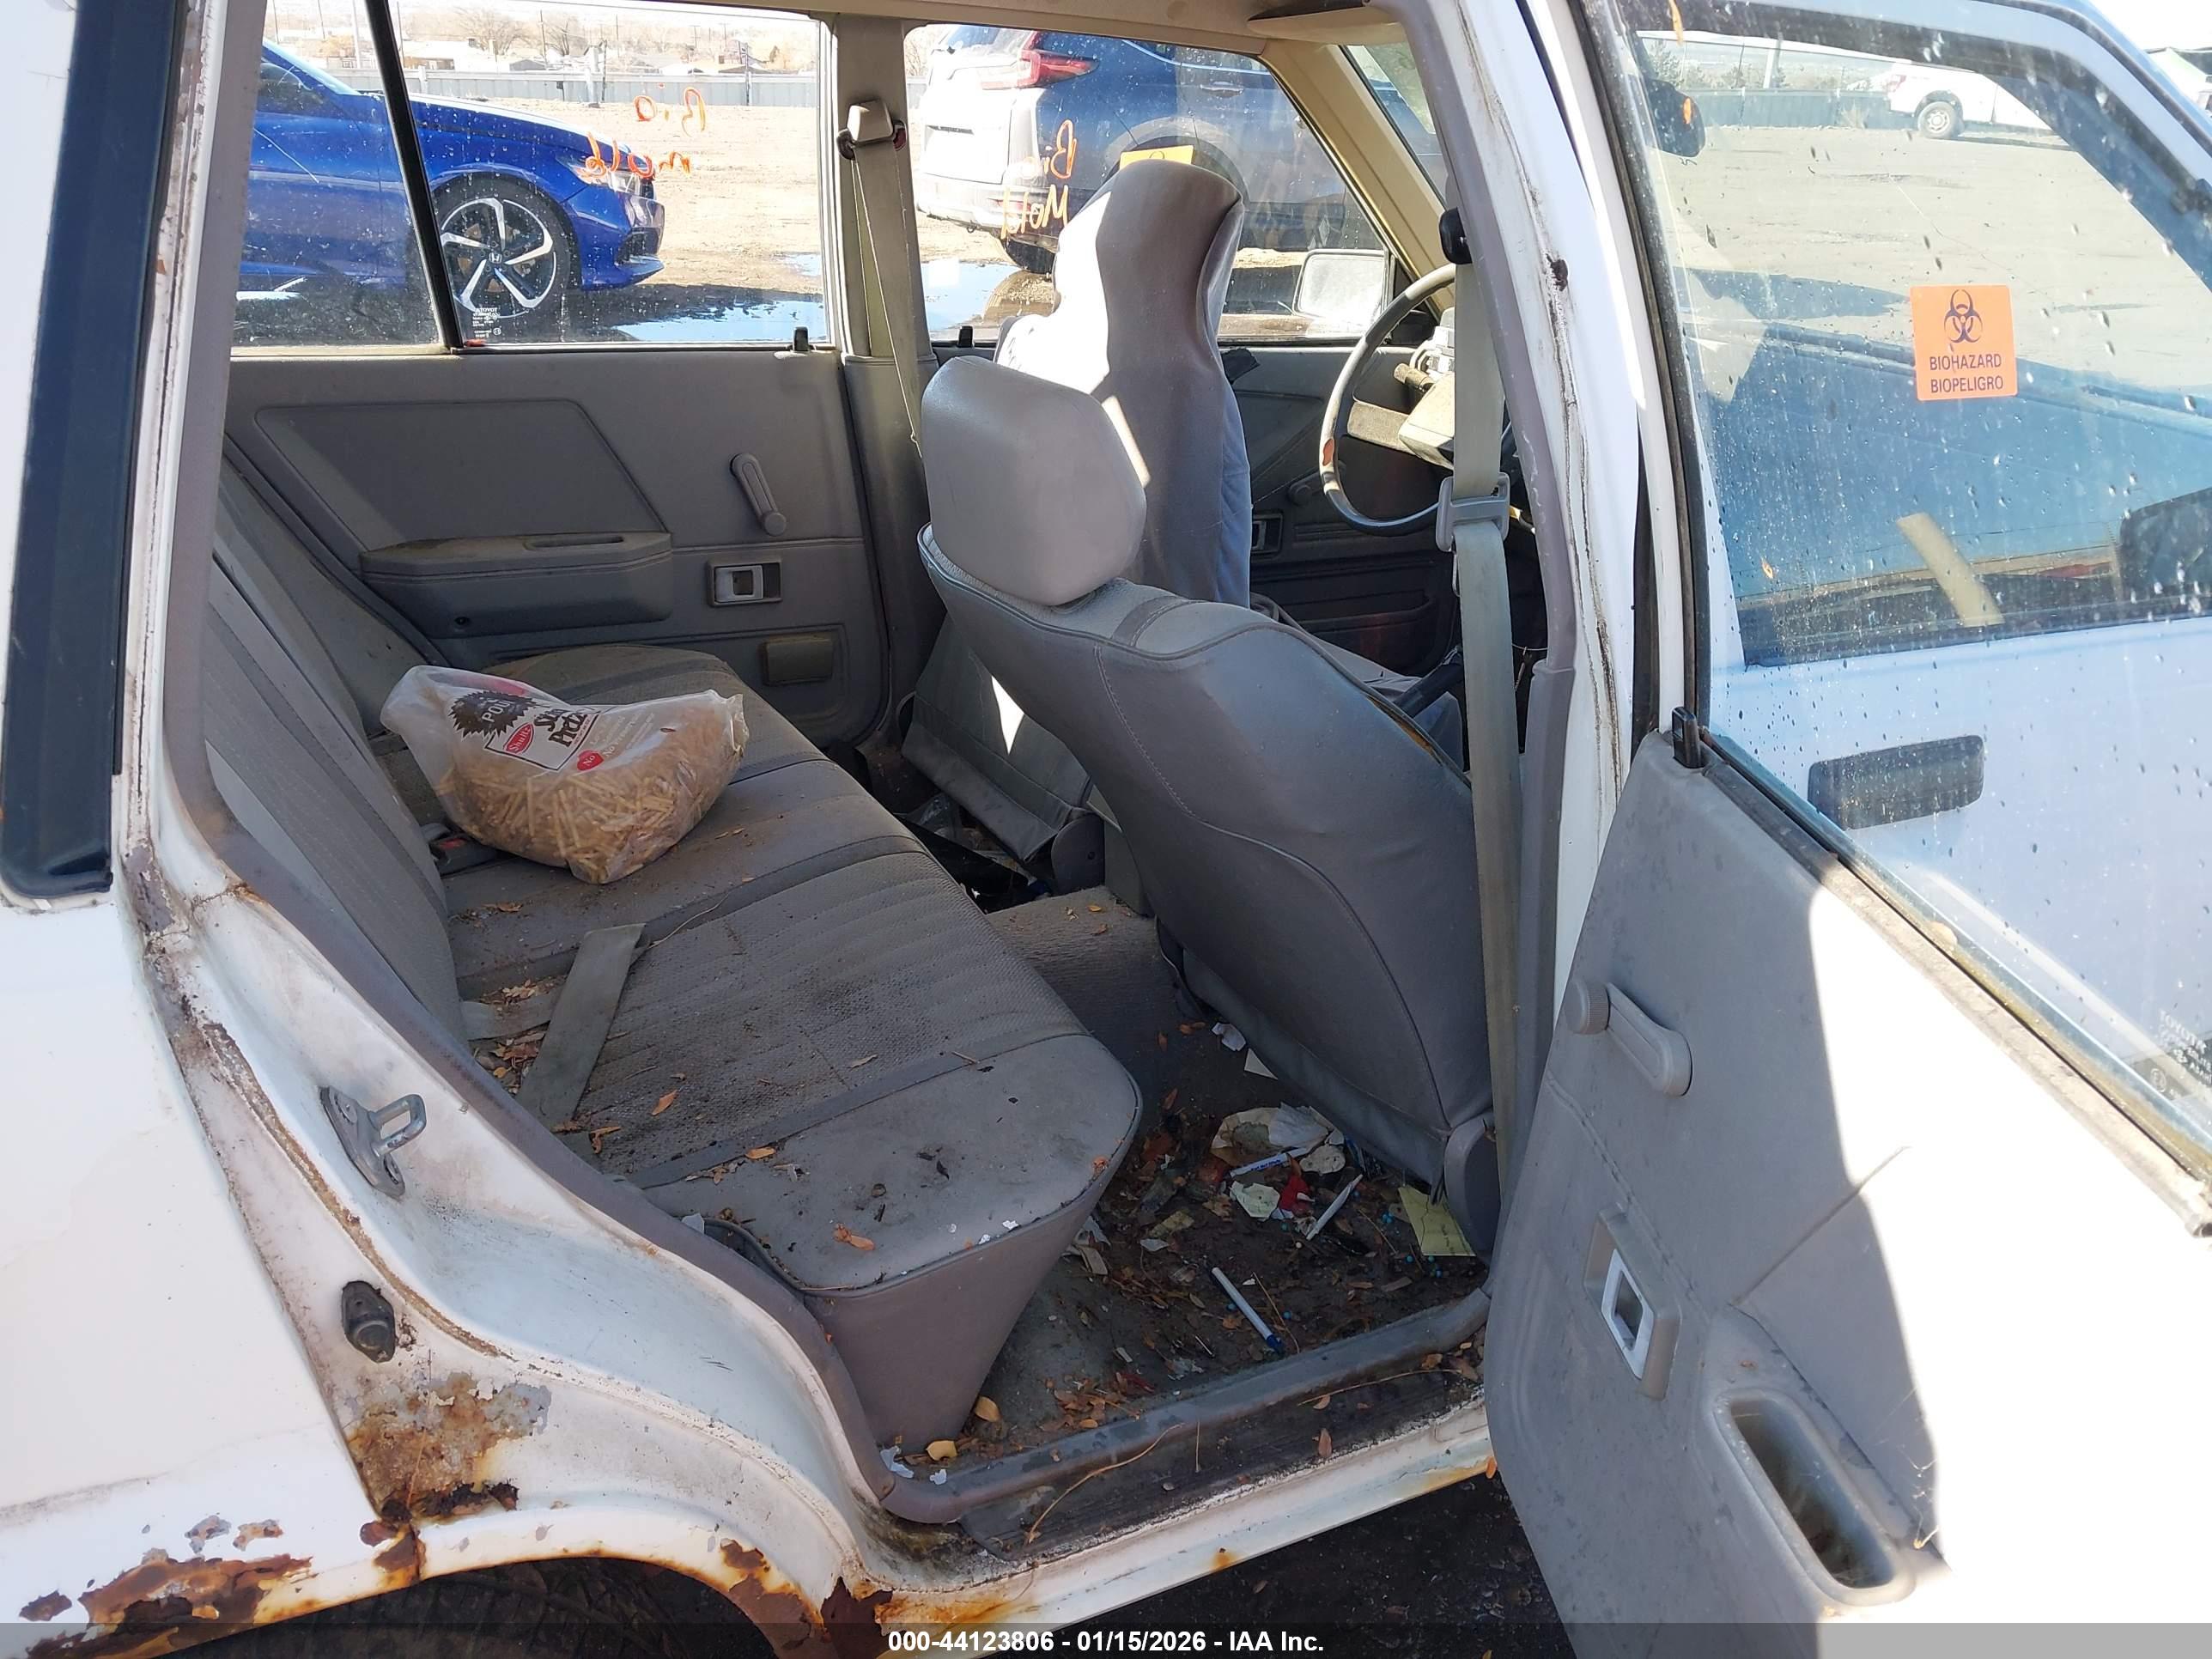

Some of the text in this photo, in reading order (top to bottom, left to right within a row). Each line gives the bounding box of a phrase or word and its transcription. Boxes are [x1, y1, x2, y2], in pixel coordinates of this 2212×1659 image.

[1929, 354, 2002, 371] BIOHAZARD
[1930, 375, 2003, 393] BIOPELIGRO
[583, 755, 596, 767] No
